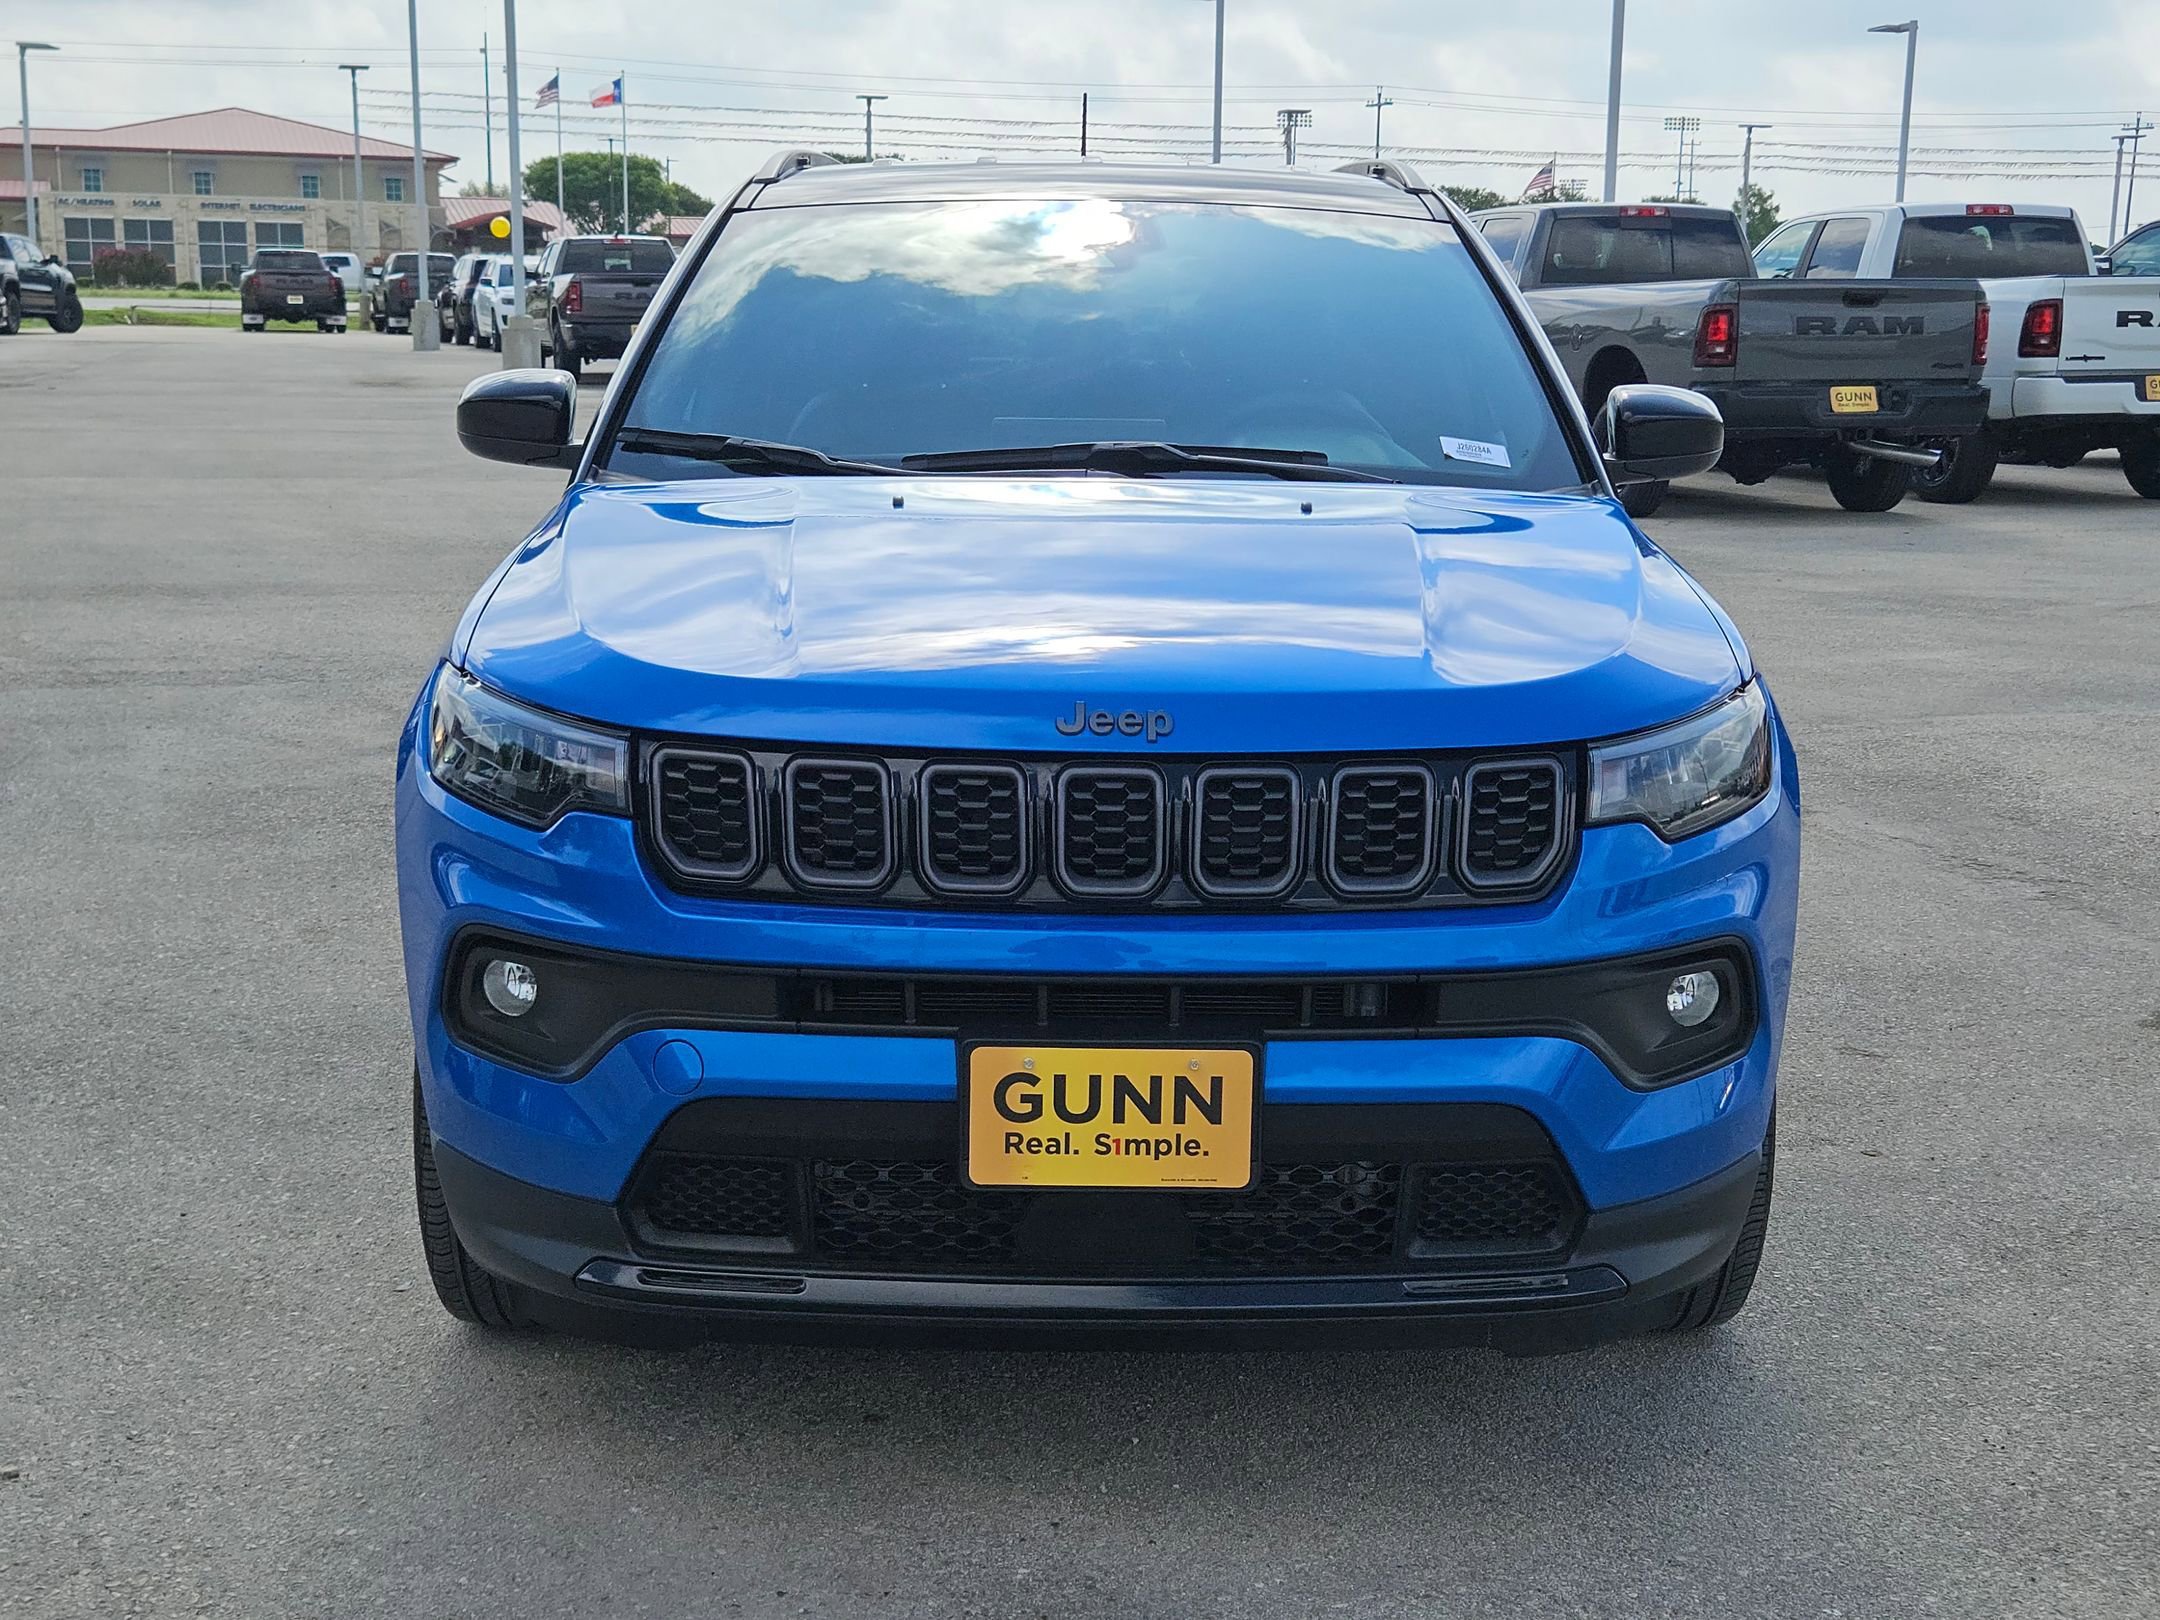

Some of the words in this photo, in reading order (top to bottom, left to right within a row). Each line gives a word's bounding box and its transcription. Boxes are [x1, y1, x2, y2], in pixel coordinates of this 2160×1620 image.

[201, 202, 241, 210] INTERNET
[249, 203, 305, 212] ELECTRICIANS
[1796, 316, 1924, 335] RAM
[2116, 311, 2160, 328] R
[1835, 392, 1872, 402] GUNN
[1056, 701, 1174, 742] Jeep
[993, 1072, 1223, 1125] GUNN
[1004, 1132, 1080, 1155] Real.
